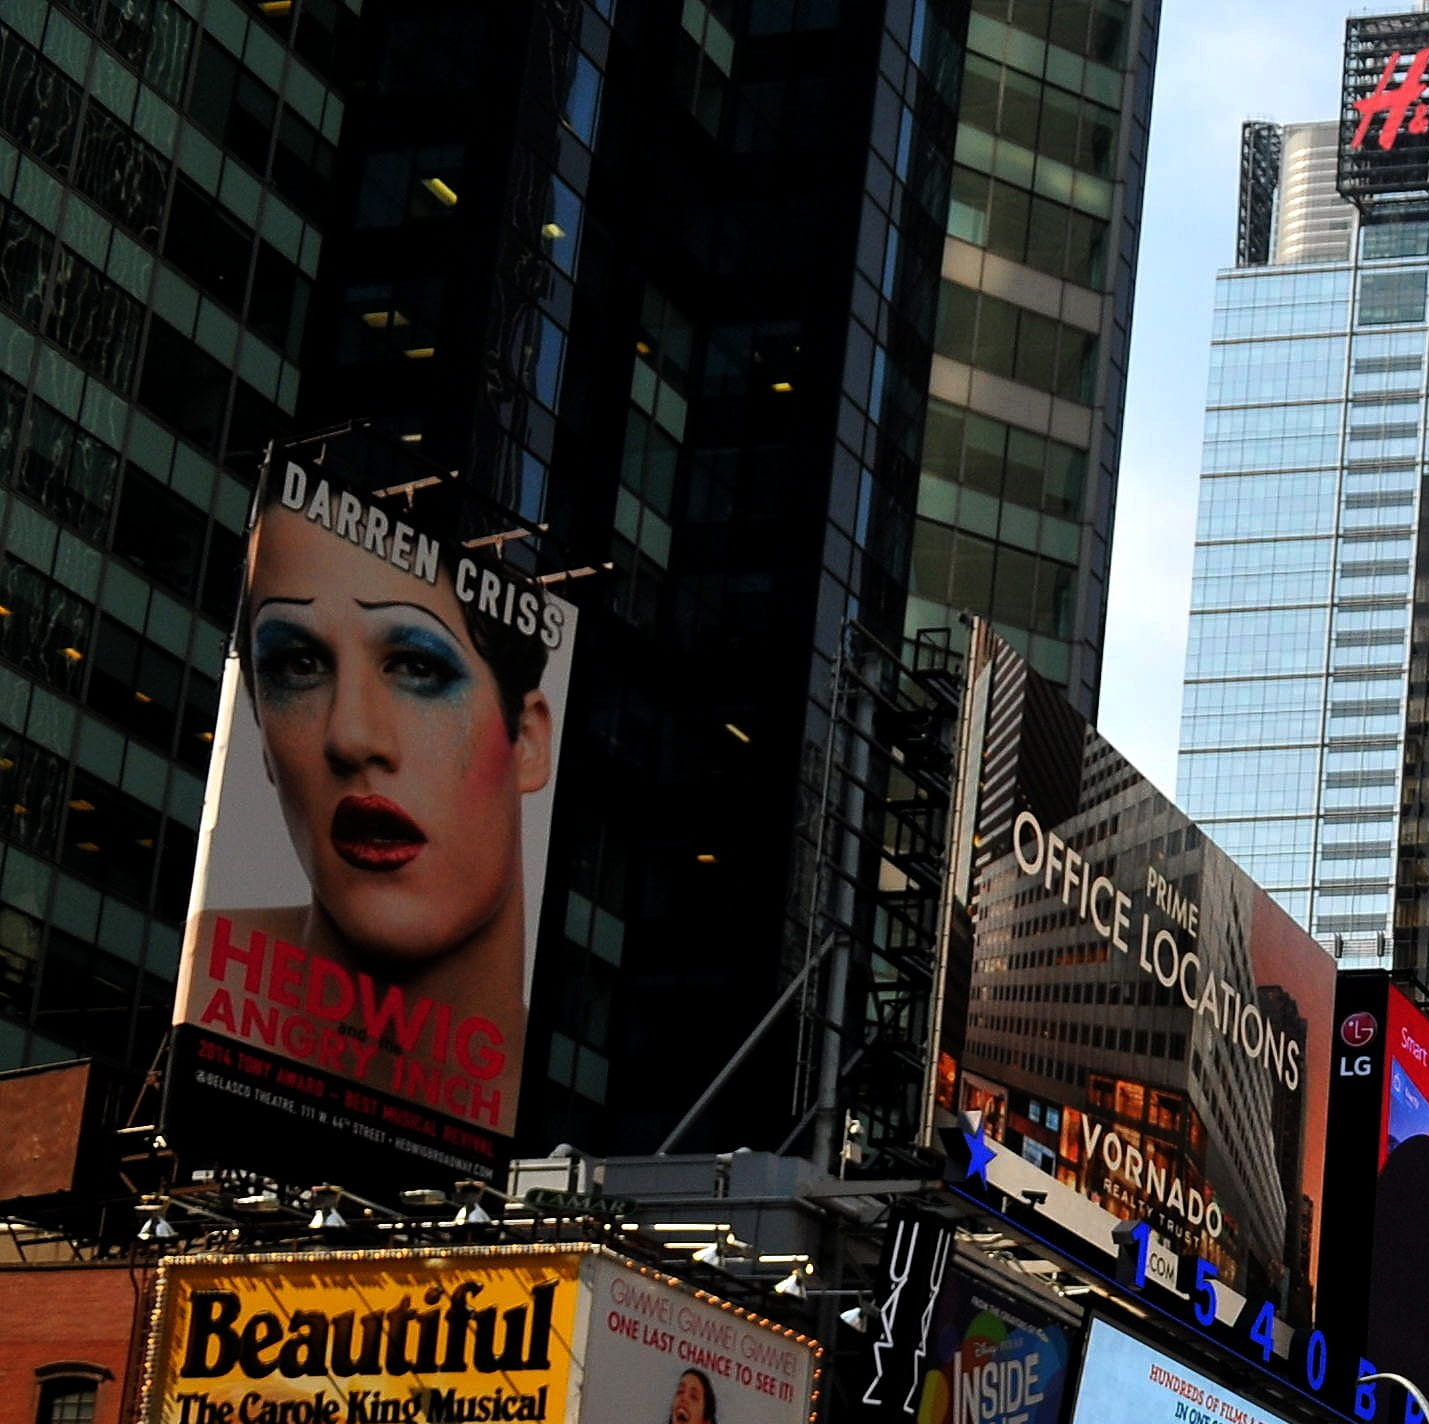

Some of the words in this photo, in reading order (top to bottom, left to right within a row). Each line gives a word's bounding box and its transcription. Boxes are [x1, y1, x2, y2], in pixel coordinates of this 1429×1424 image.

[282, 460, 440, 584] DARREN
[455, 558, 563, 648] CRISS
[1147, 865, 1199, 939] PRIME
[1013, 810, 1128, 954] OFFICE
[1139, 914, 1300, 1092] LOCATIONS
[209, 917, 505, 1080] HEDWIG
[200, 988, 377, 1080] ANGRY
[392, 1055, 500, 1127] INCH
[1340, 1056, 1371, 1076] LG
[1401, 1027, 1428, 1067] Smart
[533, 1190, 626, 1215] LAMAR
[1082, 1112, 1222, 1238] VORNADO
[1103, 1178, 1153, 1216] REALTY
[1159, 1213, 1200, 1247] TRUST
[179, 1280, 559, 1379] Beautiful
[611, 1278, 673, 1324] GIMME!
[679, 1307, 737, 1349] GIMME!
[608, 1311, 640, 1341] ONE
[644, 1327, 674, 1354] LAST
[678, 1340, 730, 1377] CHANCE
[735, 1362, 752, 1386] TO
[756, 1372, 776, 1396] SEE
[779, 1380, 793, 1401] IT!
[1150, 1364, 1204, 1407] HUNDREDS
[1207, 1391, 1218, 1411] OF
[426, 1384, 547, 1423] Musical
[1175, 1402, 1186, 1419] IN
